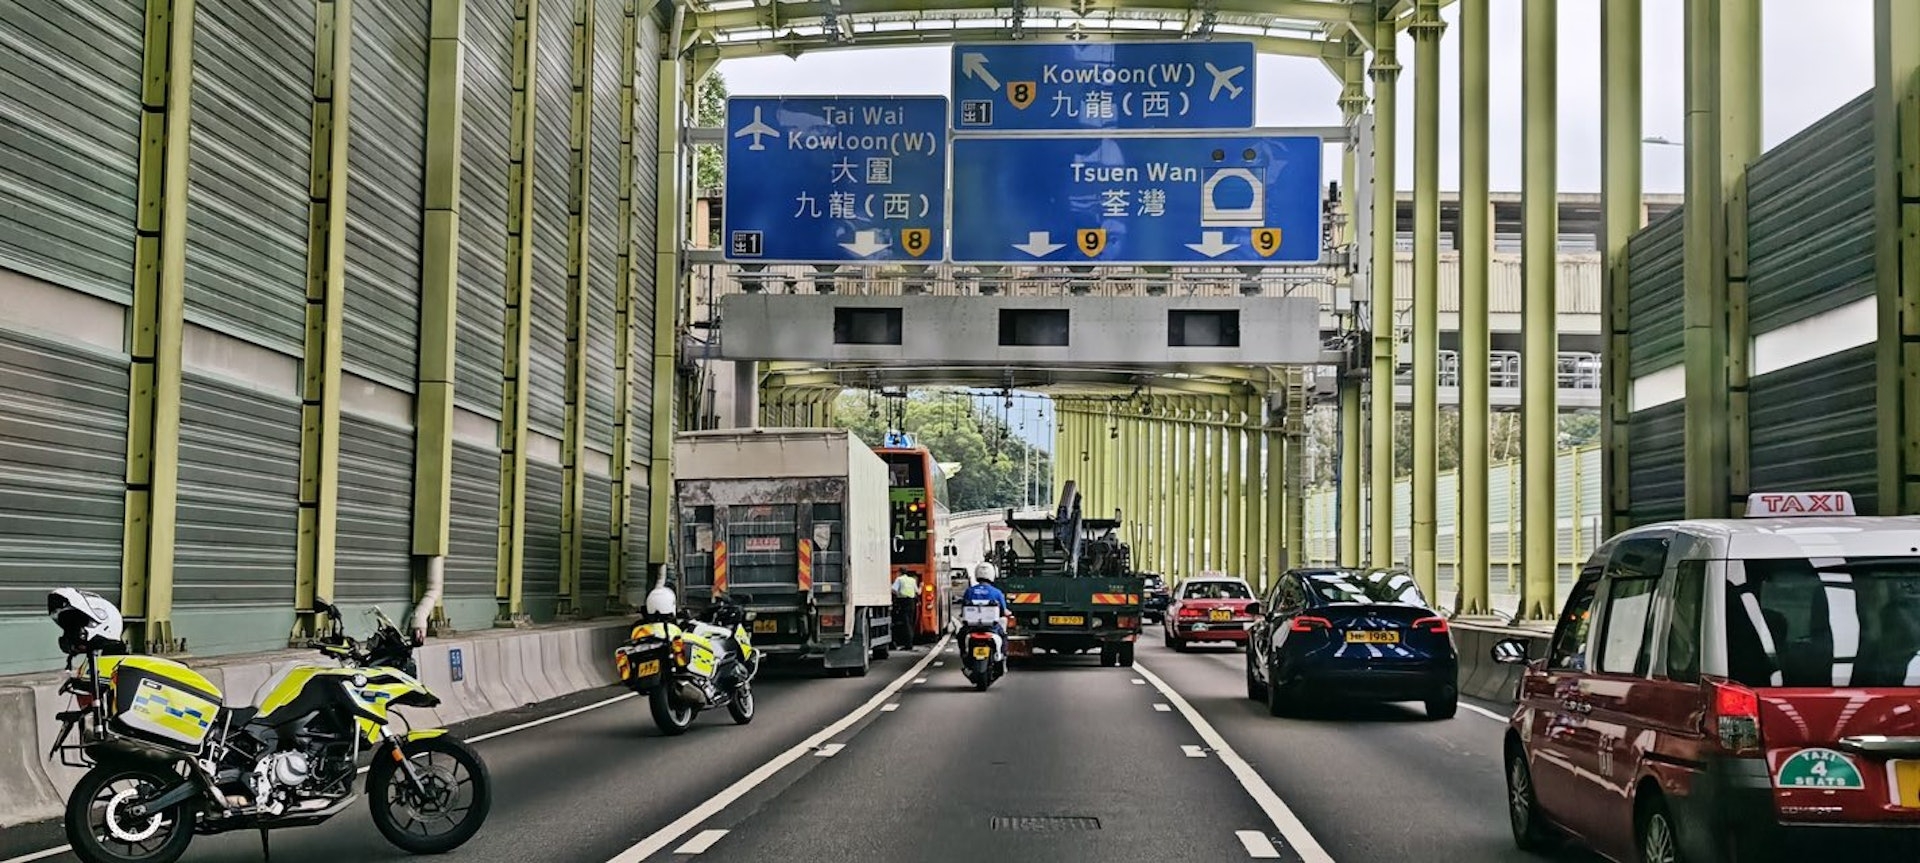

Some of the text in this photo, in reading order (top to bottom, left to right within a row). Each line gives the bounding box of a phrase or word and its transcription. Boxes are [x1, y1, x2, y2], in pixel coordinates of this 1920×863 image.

[1043, 63, 1195, 88] Kowloon(W)
[1013, 83, 1029, 103] 8
[1050, 90, 1190, 119] 九龍(西)
[822, 106, 904, 126] Tai Wai
[787, 131, 936, 156] Kowloon(W)
[831, 156, 893, 185] 大圍
[1070, 162, 1197, 182] Tsuen Wan
[794, 191, 930, 220] 九龍(西)
[1101, 188, 1167, 217] 荃灣
[908, 231, 922, 249] 8
[1084, 231, 1099, 250] 9
[1259, 231, 1274, 250] 9
[1762, 493, 1845, 514] TAXI
[1369, 632, 1396, 641] 1983
[1800, 751, 1838, 762] TAXI
[1810, 760, 1829, 777] 4
[1794, 776, 1846, 786] SEATS
